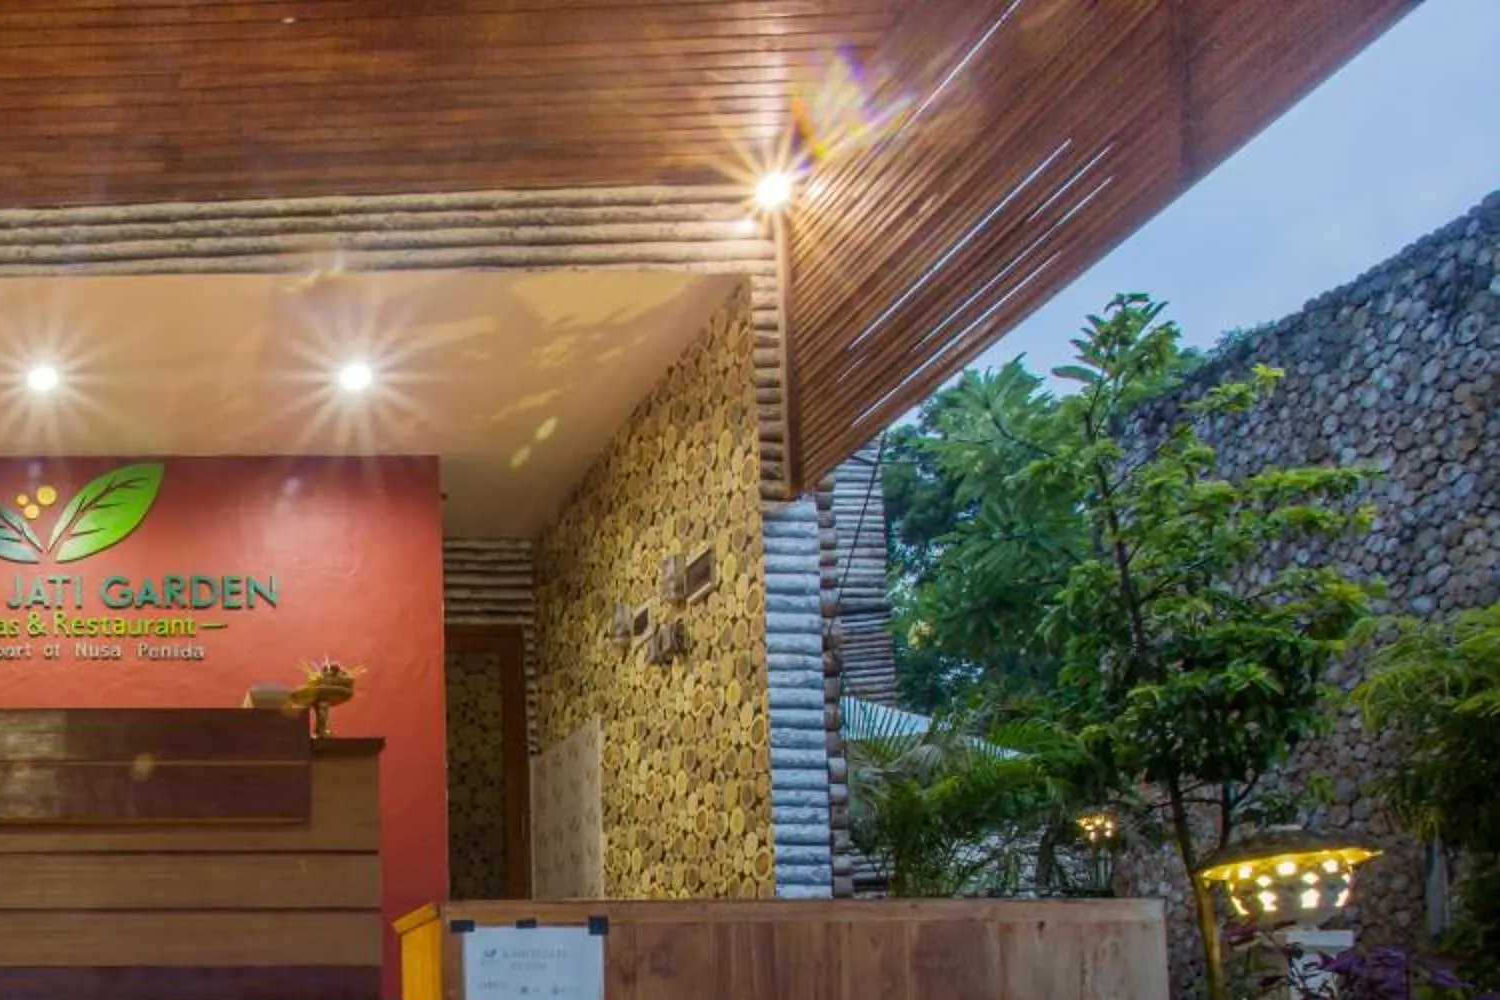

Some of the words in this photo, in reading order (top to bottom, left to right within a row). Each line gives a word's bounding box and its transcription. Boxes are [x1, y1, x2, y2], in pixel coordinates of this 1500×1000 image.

[7, 575, 83, 609] JATI
[101, 574, 278, 609] GARDEN
[26, 611, 47, 637] &
[53, 611, 197, 637] Restaurant
[44, 643, 61, 660] of
[75, 641, 122, 660] Nusa
